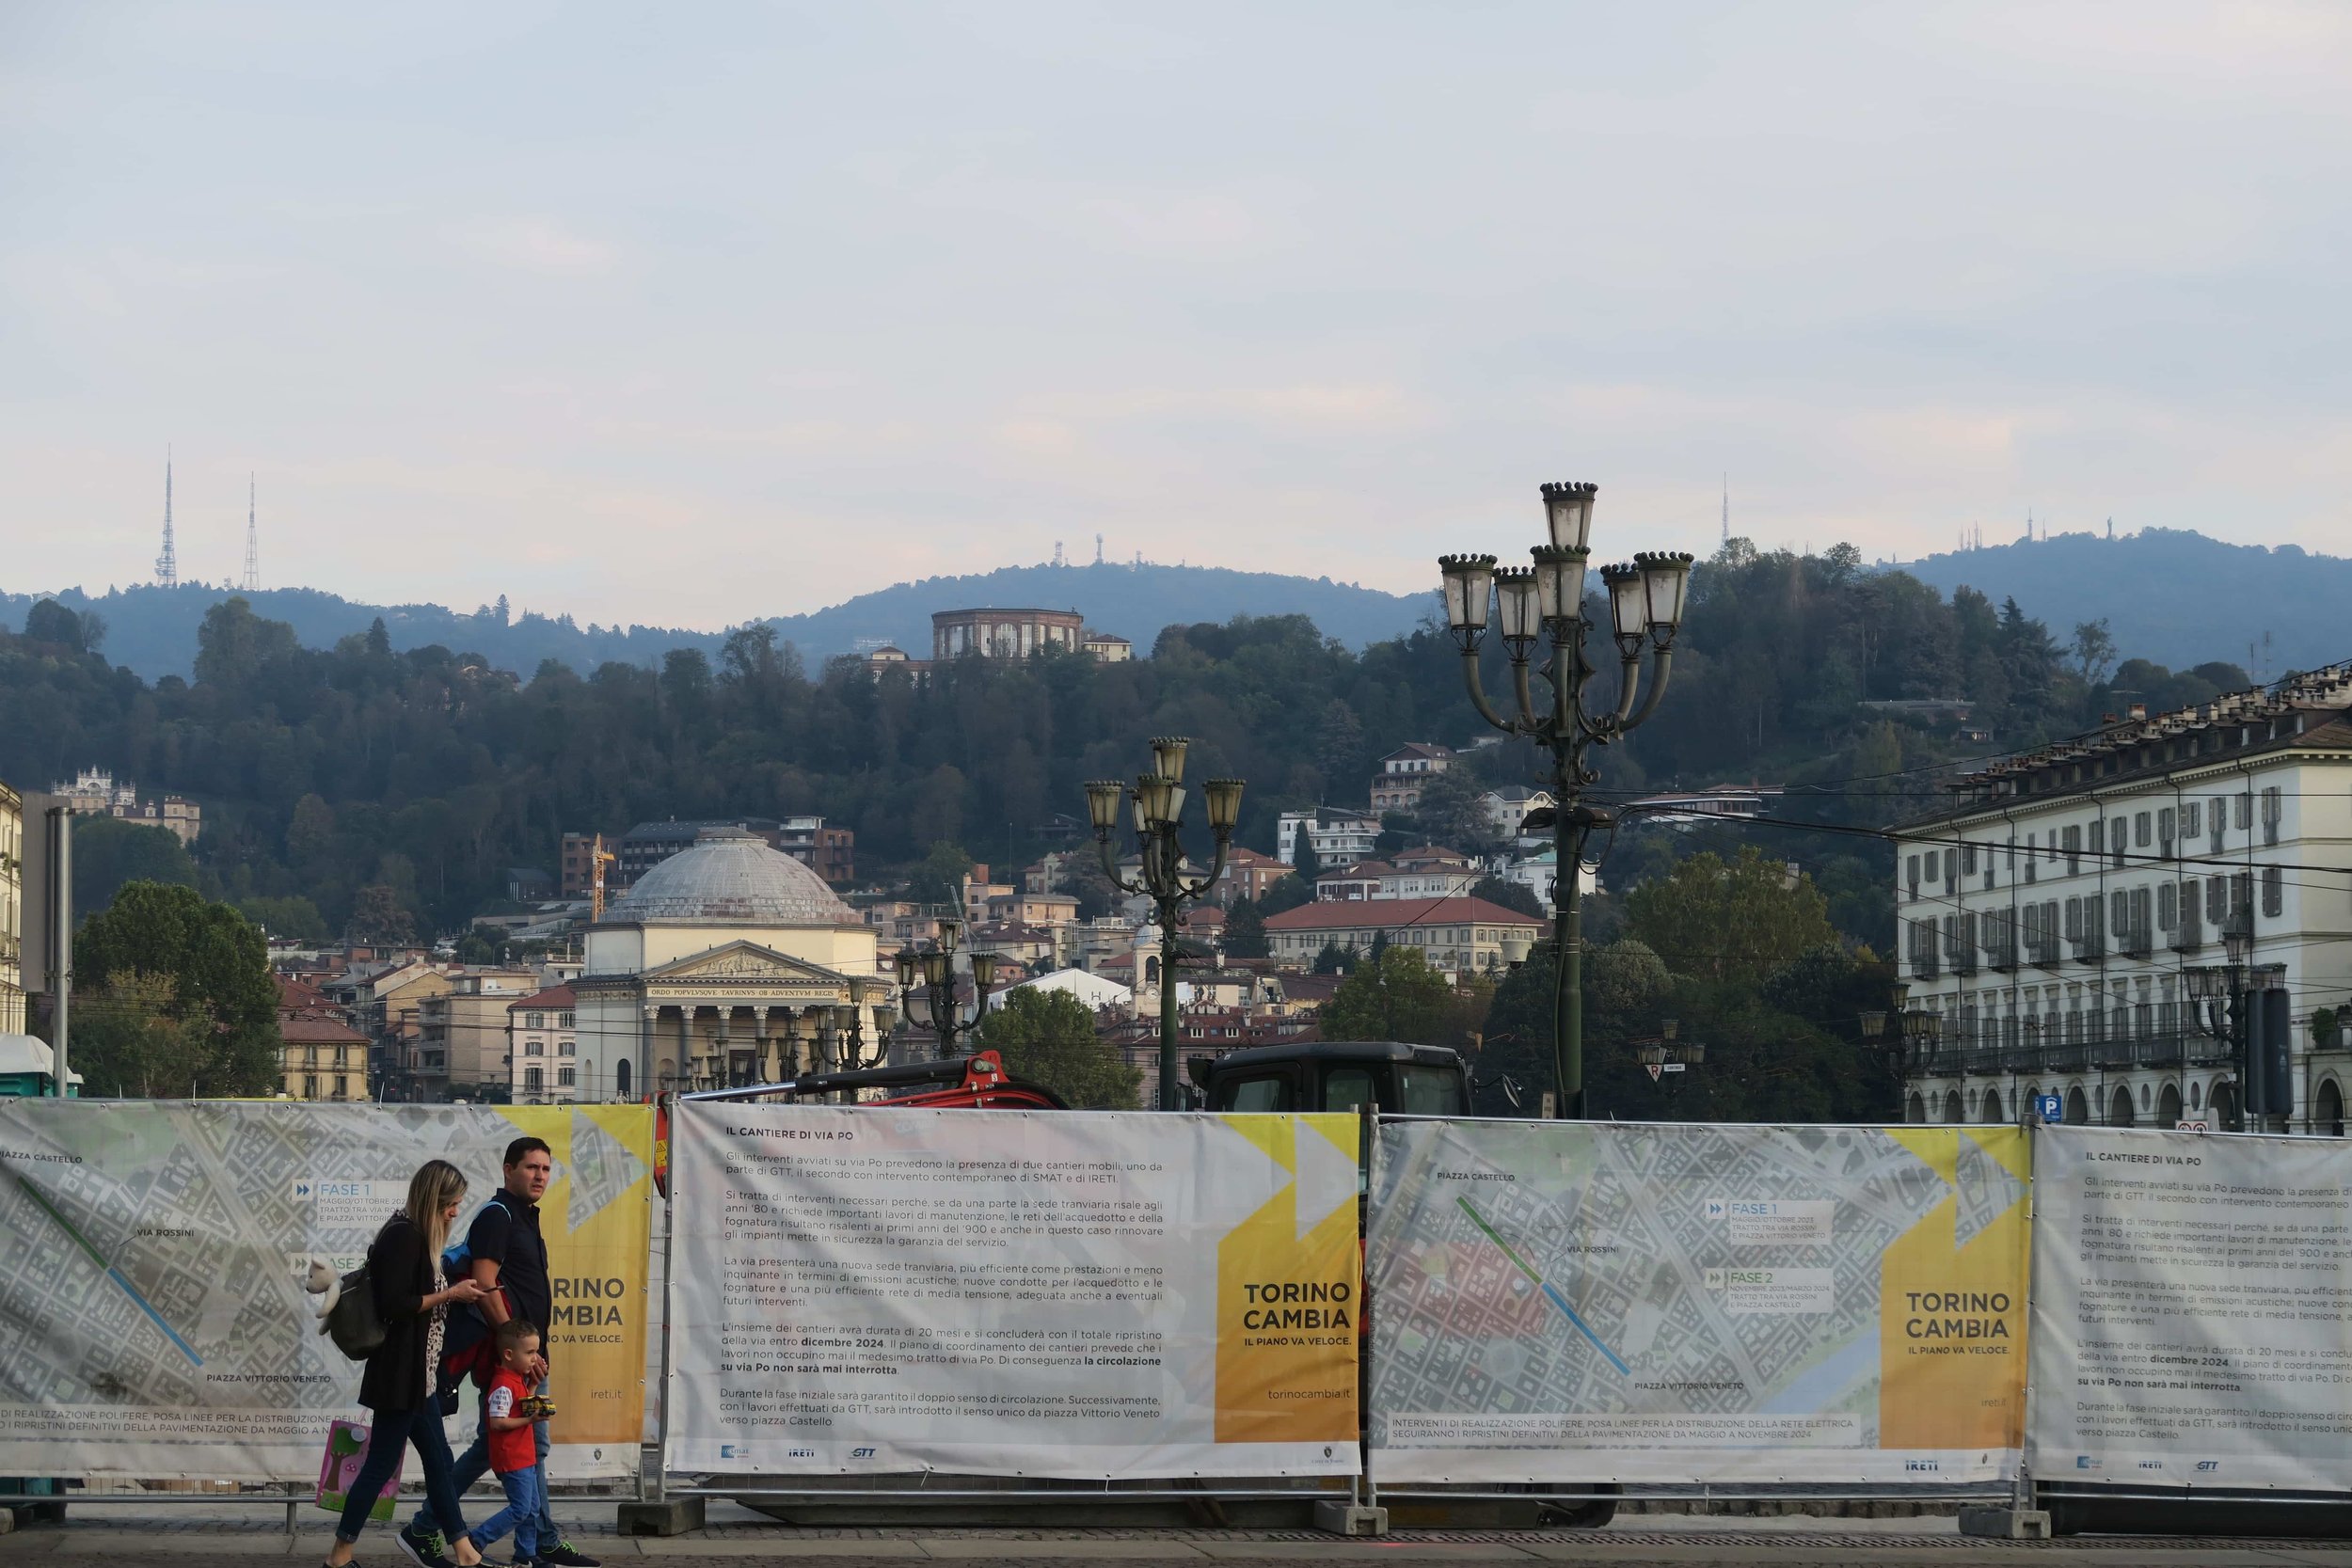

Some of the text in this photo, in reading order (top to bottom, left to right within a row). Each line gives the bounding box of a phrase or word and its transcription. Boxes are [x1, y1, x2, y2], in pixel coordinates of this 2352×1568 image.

[2046, 1101, 2057, 1114] P
[726, 1126, 853, 1140] IL CANTIERE DI VIA PO
[33, 1153, 82, 1163] CASTELLO
[726, 1151, 739, 1161] Gli
[742, 1152, 793, 1164] interventi
[868, 1158, 882, 1167] Po
[885, 1159, 942, 1168] prevedono
[946, 1160, 954, 1168] la
[958, 1161, 1006, 1170] presenza
[1009, 1160, 1019, 1169] di
[1022, 1161, 1043, 1170] due
[1045, 1161, 1084, 1170] cantieri
[1088, 1162, 1123, 1171] mobili,
[1149, 1162, 1162, 1171] da
[2086, 1152, 2201, 1166] IL CANTIERE DI VIA PO
[1471, 1172, 1515, 1181] CASTELLO
[321, 1183, 369, 1196] FASE 1
[391, 1197, 405, 1206] 202
[1732, 1203, 1777, 1214] FASE 1
[137, 1228, 194, 1237] VIA ROSSINI
[1730, 1272, 1773, 1283] FASE 2
[553, 1278, 625, 1299] RINO
[1244, 1283, 1350, 1304] TORINO
[1907, 1292, 2010, 1313] TORINO
[552, 1305, 623, 1326] MBIA
[1243, 1309, 1351, 1330] CAMBIA
[1906, 1318, 2010, 1338] CAMBIA
[562, 1334, 576, 1343] VA
[579, 1334, 623, 1343] VELOCE.
[1256, 1337, 1288, 1345] PIANO
[1307, 1337, 1351, 1345] VELOCE.
[721, 1336, 747, 1344] della
[769, 1337, 798, 1345] entro
[800, 1337, 852, 1346] dicembre
[890, 1339, 896, 1347] Il
[899, 1340, 929, 1349] piano
[932, 1341, 942, 1350] di
[946, 1342, 1026, 1351] coordinamento
[1028, 1343, 1044, 1351] dei
[1091, 1344, 1133, 1353] prevede
[1136, 1344, 1155, 1352] che
[721, 1349, 750, 1357] lavori
[775, 1351, 825, 1360] occupino
[850, 1351, 855, 1360] il
[858, 1353, 914, 1362] medesimo
[916, 1354, 946, 1362] tratto
[948, 1355, 959, 1363] di
[961, 1356, 977, 1364] via
[979, 1355, 995, 1364] Po.
[998, 1355, 1009, 1364] Di
[1012, 1357, 1081, 1366] conseguenza
[1084, 1356, 1093, 1365] la
[1096, 1356, 1161, 1365] circolazione
[2150, 1355, 2198, 1364] dicembre
[736, 1362, 752, 1371] via
[755, 1362, 770, 1371] Po
[797, 1364, 819, 1372] sarà
[822, 1364, 842, 1373] mai
[2091, 1377, 2105, 1385] via
[2107, 1377, 2121, 1386] Po
[2169, 1380, 2187, 1389] mai
[590, 1389, 622, 1399] ireti.it
[1268, 1388, 1351, 1399] torinocambia.it
[751, 1415, 787, 1425] piazza
[789, 1416, 834, 1426] Castello.
[1392, 1418, 1447, 1427] INTERVENTI
[1449, 1419, 1460, 1429] DI
[1461, 1419, 1536, 1427] REALIZZAZIONE
[1511, 1430, 1558, 1439] DEFINITIVI
[851, 1448, 876, 1457] GTT
[1905, 1459, 1939, 1471] IRETI
[2197, 1461, 2219, 1471] GTT
